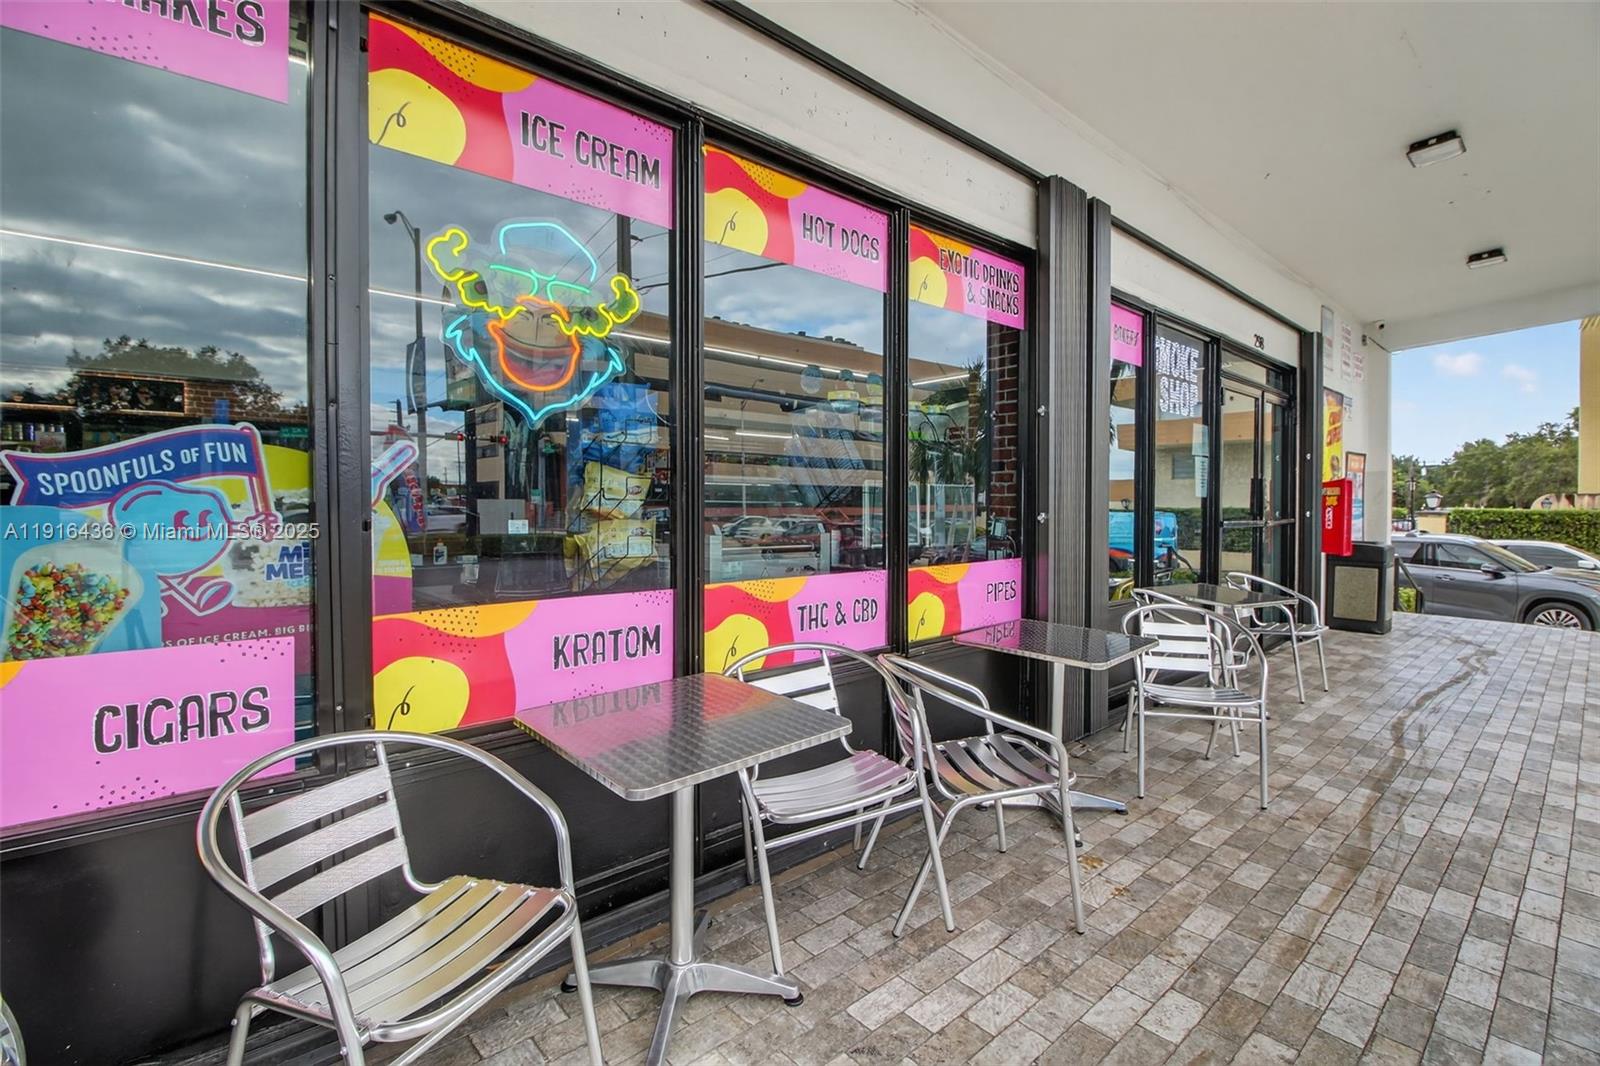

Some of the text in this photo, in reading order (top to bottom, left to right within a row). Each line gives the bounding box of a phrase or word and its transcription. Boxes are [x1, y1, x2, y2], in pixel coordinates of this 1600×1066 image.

[520, 110, 662, 191] ICE CREAM
[802, 211, 881, 262] HOT DOGS
[940, 247, 1020, 294] EXOTIC DRINKS
[966, 281, 1020, 317] & SNACKS
[1155, 335, 1200, 383] MOKE
[1159, 375, 1199, 417] SHOP
[37, 441, 247, 496] SPOONFULS OF FUN
[986, 579, 1017, 602] PIPES
[223, 628, 272, 643] CREAM.
[274, 625, 296, 636] BIG
[797, 597, 878, 632] THC & CBD
[552, 624, 662, 671] KRATOM
[93, 685, 271, 754] CIGARS
